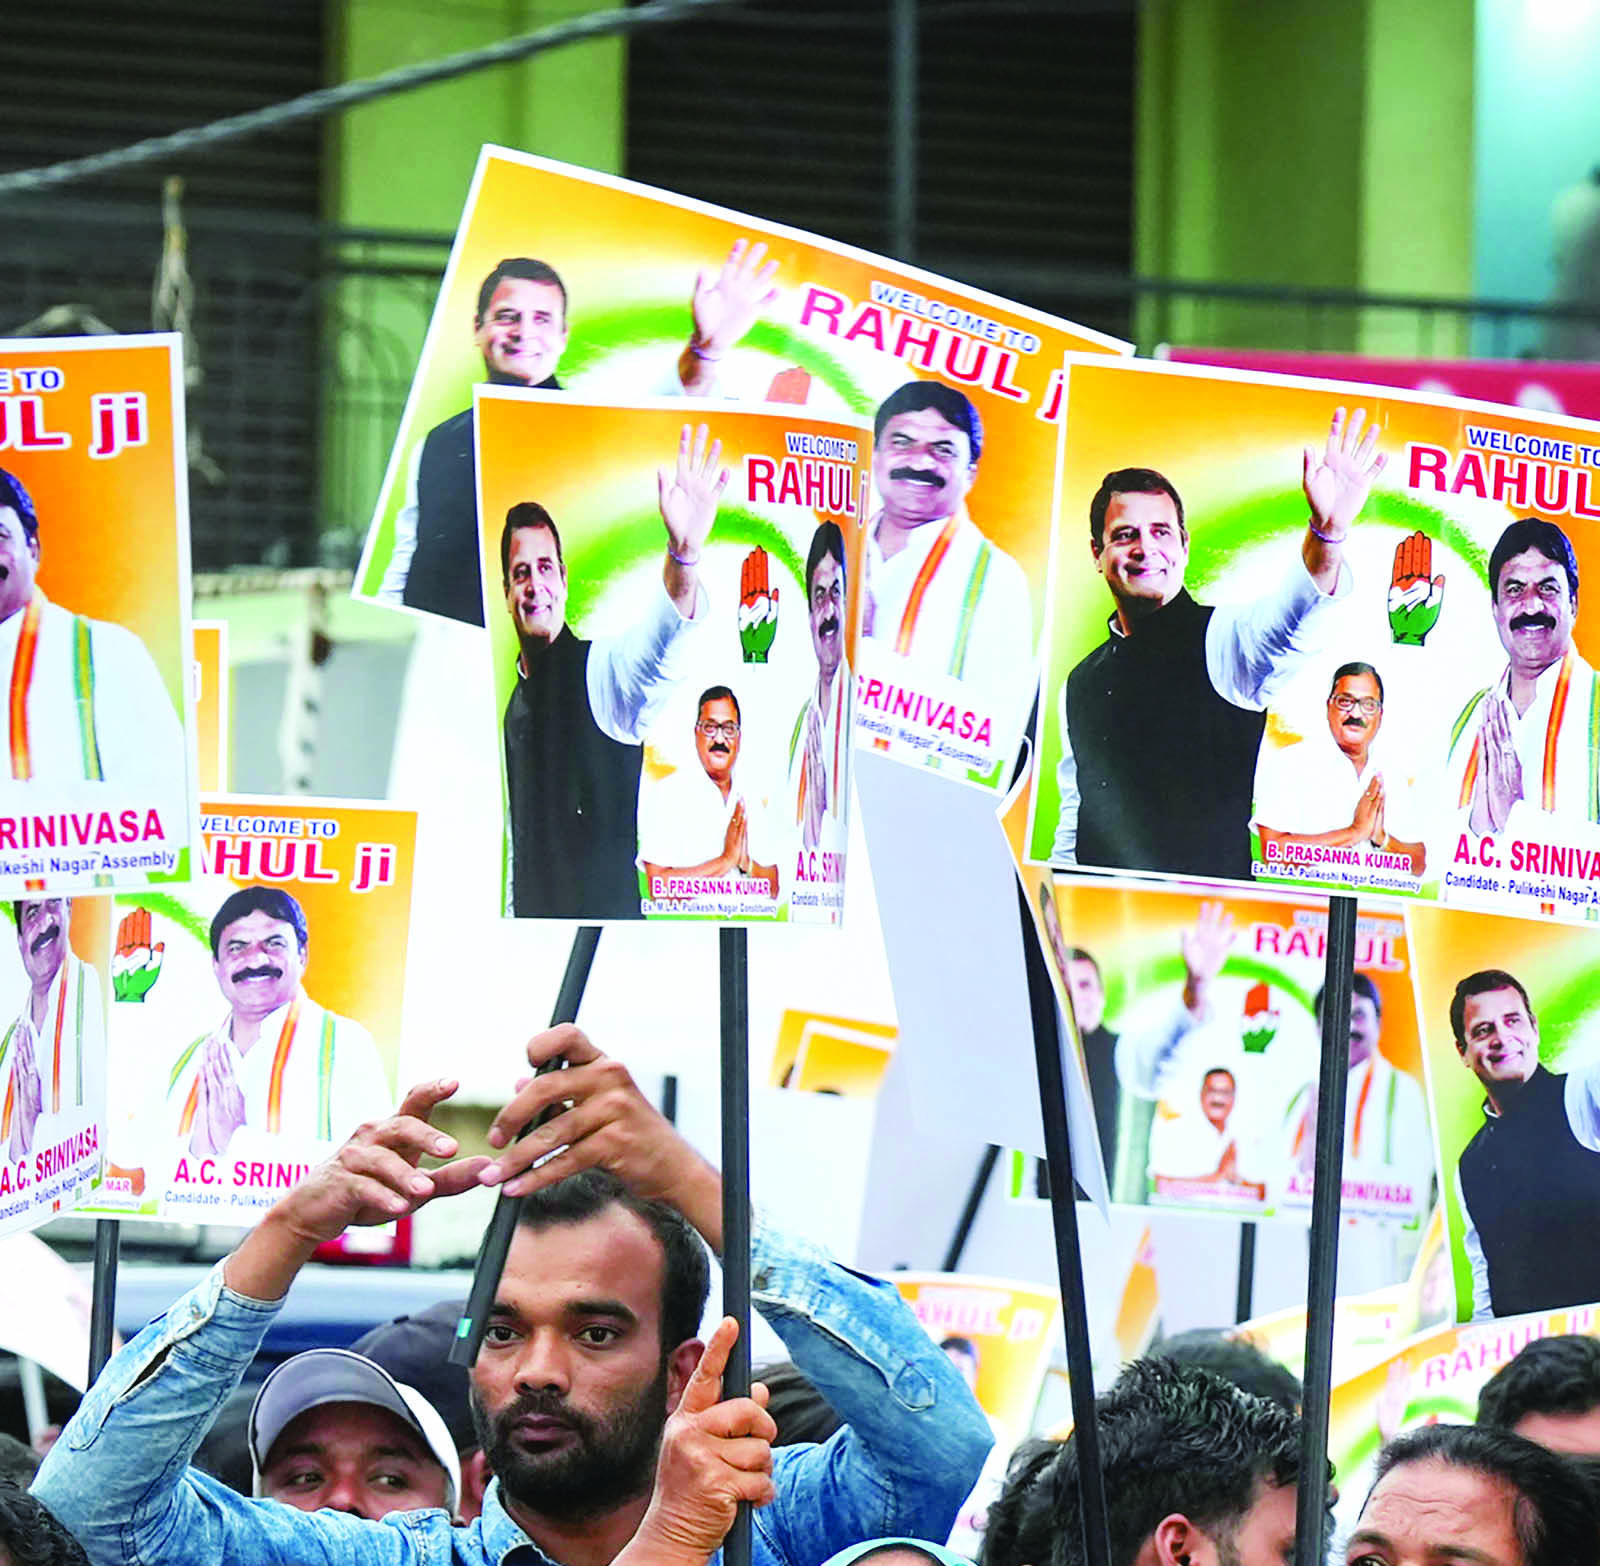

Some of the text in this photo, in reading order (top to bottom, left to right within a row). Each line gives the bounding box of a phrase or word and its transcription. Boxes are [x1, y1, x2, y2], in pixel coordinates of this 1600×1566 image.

[875, 284, 1038, 353] WELCOME TO
[800, 286, 1024, 398] RAHUL
[19, 368, 61, 391] TO
[93, 399, 144, 455] ji
[788, 435, 845, 458] WELCOME
[1469, 428, 1573, 462] WELCOME
[748, 458, 856, 513] RAHUL
[310, 821, 337, 837] TO
[50, 858, 97, 875] Nagar
[102, 852, 176, 870] Assembly
[796, 851, 819, 882] A.C.
[1267, 844, 1410, 871] B. PRASANNA KUMAR
[1454, 834, 1501, 868] A.C.
[355, 847, 390, 889] ji
[1270, 865, 1421, 892] M.L.A. Pulikeshi Nagar Constituency
[654, 881, 769, 896] B. PRASANNA KUMAR
[1445, 872, 1499, 892] Candidate
[1508, 879, 1556, 900] Pulikeshi
[1558, 887, 1589, 906] Nagar
[0, 1124, 98, 1197] A.C. SRINIVASA
[174, 1159, 222, 1187] A.C.
[165, 1191, 218, 1205] Candidate
